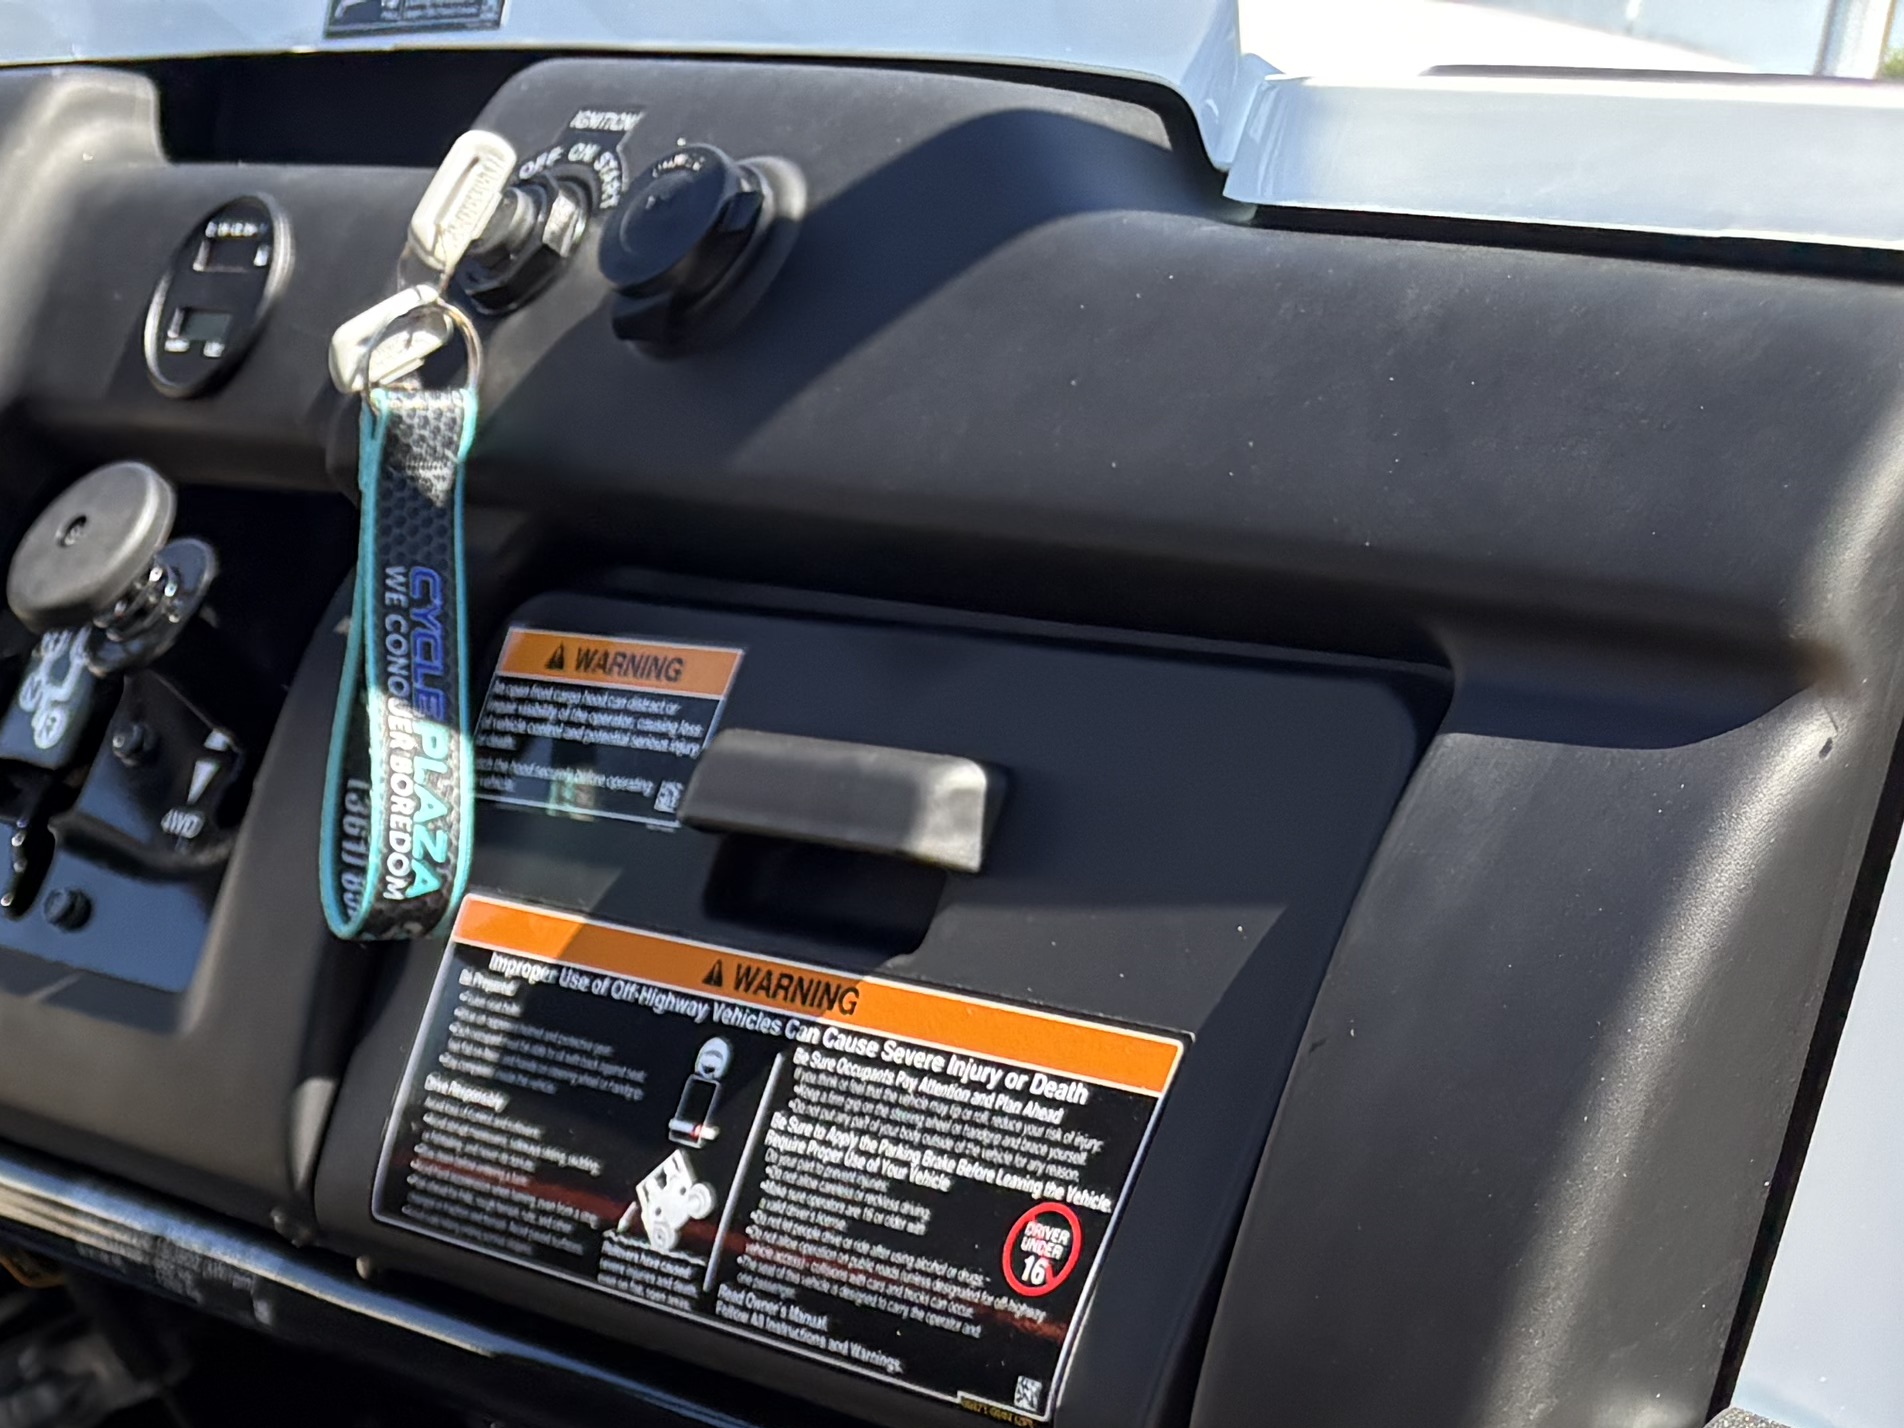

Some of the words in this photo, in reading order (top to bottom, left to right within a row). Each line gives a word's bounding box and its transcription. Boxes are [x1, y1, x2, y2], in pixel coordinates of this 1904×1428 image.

[569, 108, 644, 131] IGNITION
[518, 145, 563, 179] OFF
[567, 142, 599, 163] ON
[385, 565, 407, 609] WE
[410, 566, 446, 720] CYCLE
[569, 647, 687, 682] WARNING
[383, 611, 414, 750] CONQUER
[382, 751, 414, 901] BOREDOM
[405, 718, 449, 900] PLAZA
[731, 964, 860, 1015] WARNING
[489, 952, 557, 984] Improper
[559, 968, 590, 991] Use
[592, 977, 611, 994] of
[611, 980, 710, 1023] Off-Highway
[713, 1002, 782, 1035] Vehicles
[785, 1019, 821, 1044] Can
[823, 1027, 880, 1057] Cause
[881, 1040, 945, 1072] Severe
[947, 1054, 1004, 1089] Injury
[1005, 1072, 1029, 1090] or
[1030, 1073, 1089, 1105] Death
[793, 1047, 810, 1065] Be
[810, 1051, 836, 1072] Sure
[836, 1057, 895, 1085] Occupants
[895, 1071, 918, 1093] Pay
[918, 1076, 971, 1102] Attention
[970, 1092, 996, 1109] and
[995, 1094, 1023, 1114] Plan
[1022, 1101, 1064, 1124] Ahead
[765, 1129, 806, 1154] Require
[806, 1140, 843, 1163] Proper
[844, 1149, 866, 1170] Use
[866, 1157, 880, 1172] of
[882, 1159, 908, 1179] Your
[771, 1112, 787, 1130] Be
[787, 1116, 813, 1137] Sure
[813, 1124, 826, 1140] to
[826, 1126, 859, 1151] Apply
[859, 1135, 878, 1153] the
[878, 1139, 922, 1168] Parking
[922, 1150, 956, 1173] Brake
[956, 1158, 995, 1183] Before
[996, 1168, 1043, 1198] Leaving
[1043, 1181, 1065, 1200] the
[1021, 1237, 1063, 1259] UNDER
[1025, 1221, 1070, 1245] DRIVER
[1022, 1255, 1049, 1285] 16
[718, 1284, 745, 1305] Read
[746, 1292, 787, 1318] Owner's
[716, 1300, 749, 1323] Follow
[751, 1312, 768, 1328] All
[766, 1317, 826, 1348] Instructions
[828, 1339, 852, 1355] and
